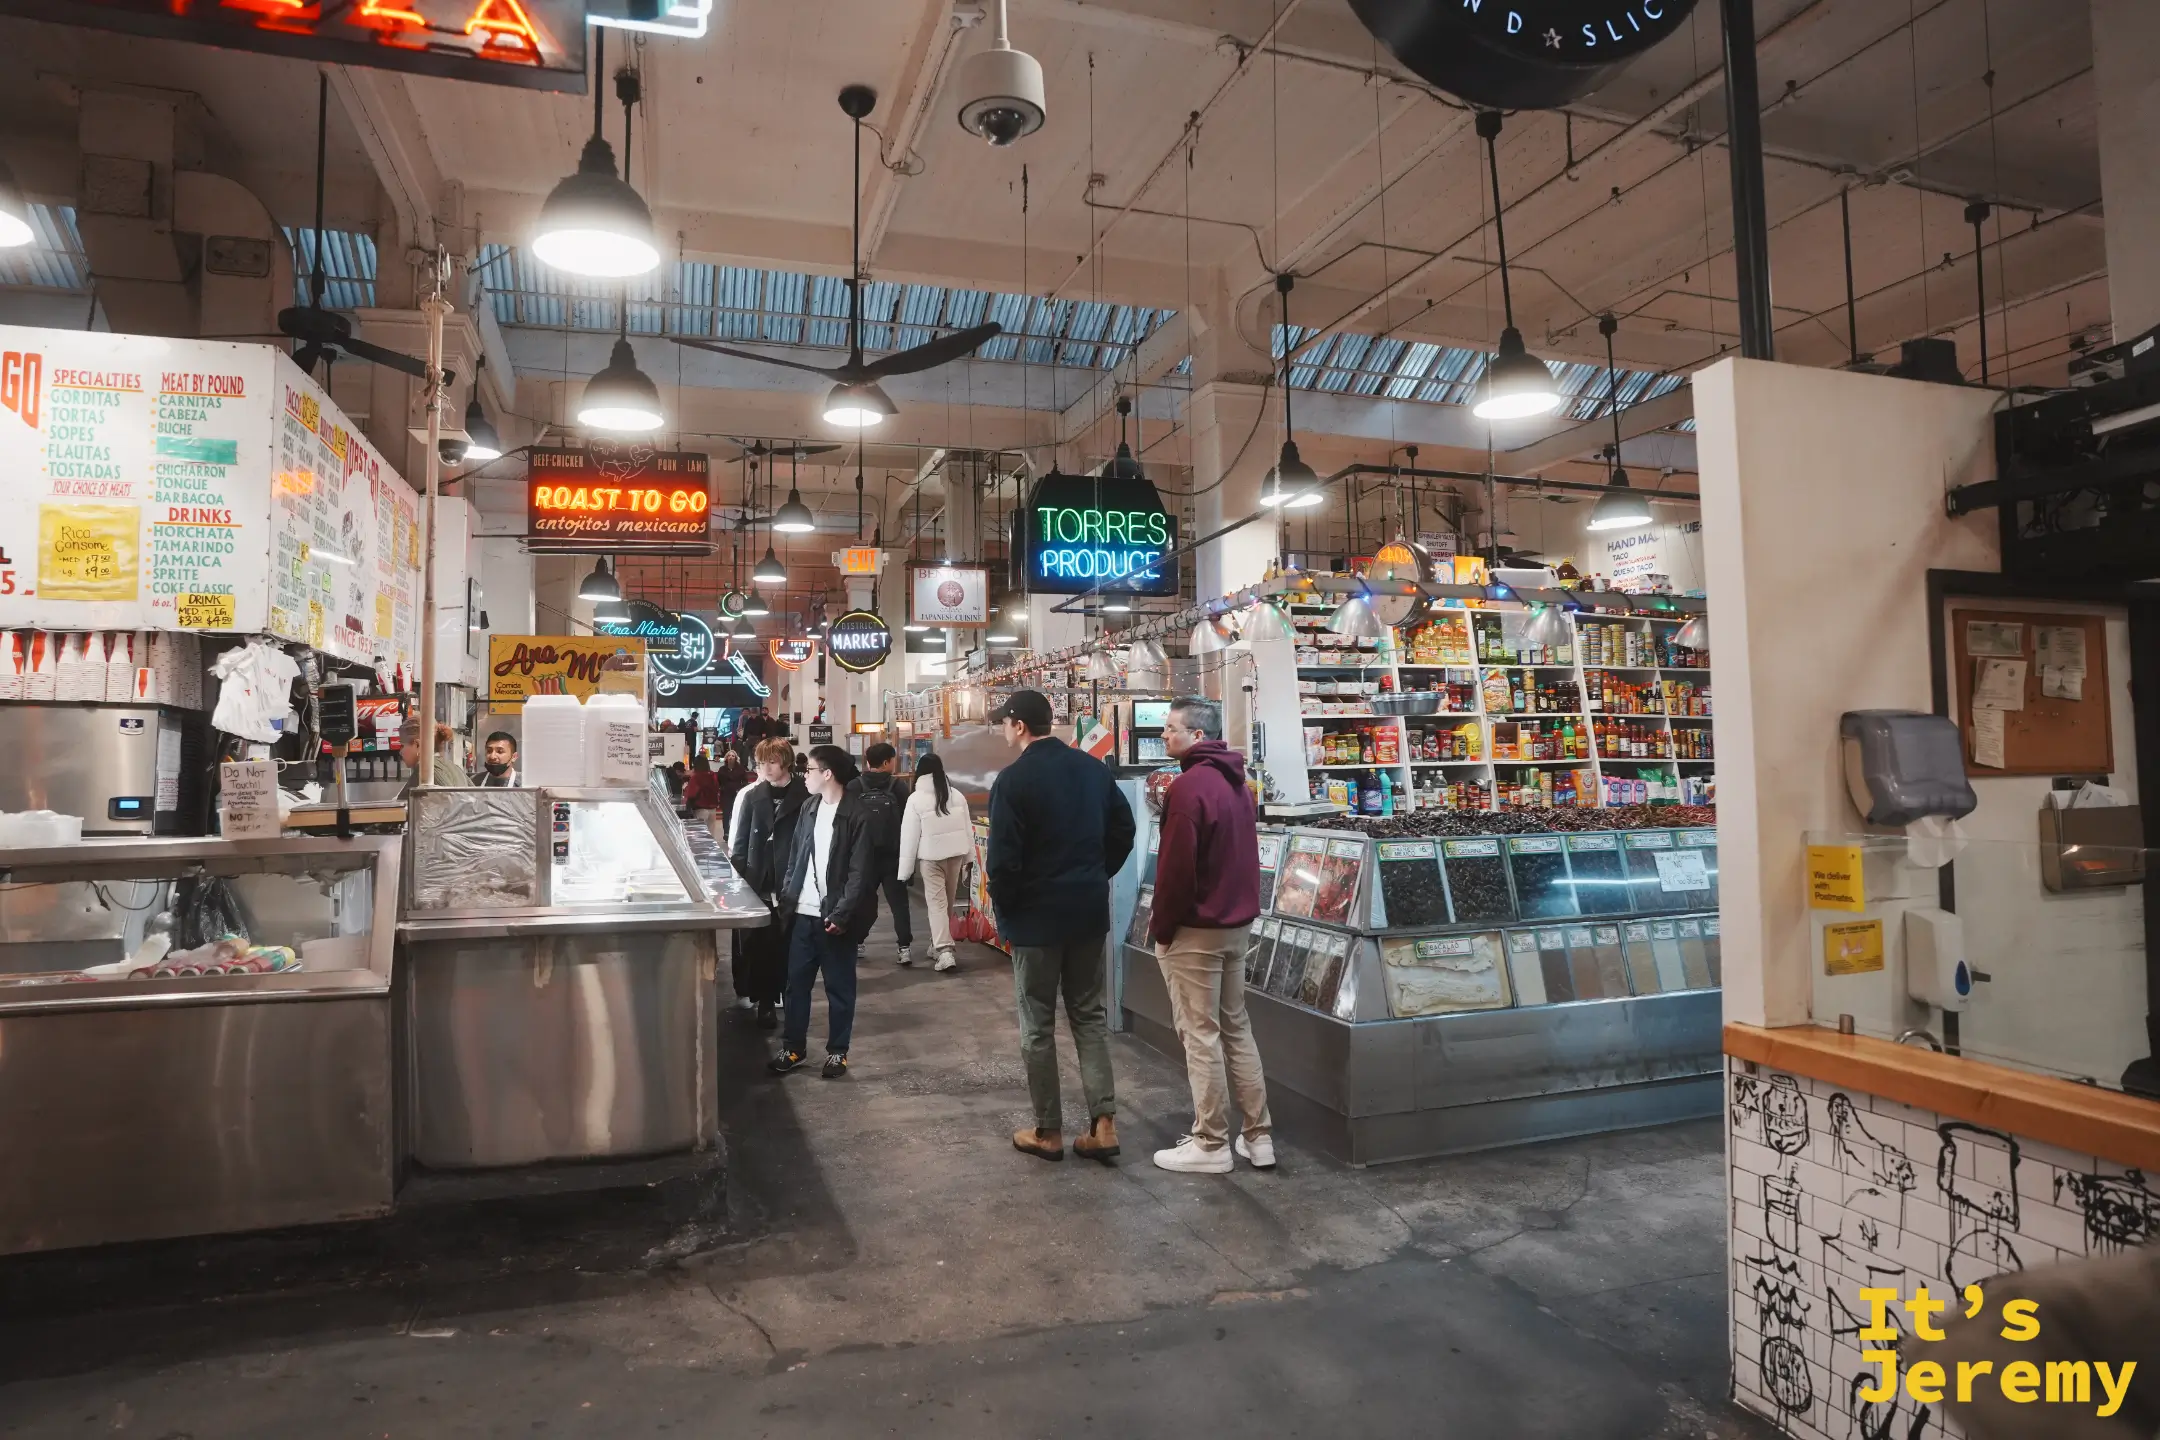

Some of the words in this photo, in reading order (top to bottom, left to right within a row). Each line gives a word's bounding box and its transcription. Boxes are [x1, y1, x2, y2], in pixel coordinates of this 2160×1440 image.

[53, 369, 141, 389] SPECIALTIES
[161, 372, 189, 392] MEAT
[192, 373, 205, 393] BY
[208, 375, 244, 395] POUND
[0, 351, 42, 430] GO
[50, 389, 121, 407] GORDITAS
[159, 395, 222, 409] CARNITAS
[50, 407, 105, 424] TORTAS
[158, 408, 207, 421] CABEZA
[49, 425, 95, 441] SOPES
[157, 422, 192, 435] BUCHE
[48, 444, 111, 461] FLAUTAS
[48, 461, 121, 479] TOSTADAS
[156, 463, 226, 478] CHICHARRON
[687, 459, 707, 473] LAMB
[52, 480, 71, 494] YOUR
[72, 481, 98, 496] CHOICE
[98, 483, 108, 496] OF
[109, 484, 132, 497] MEATS
[156, 477, 208, 490] TONGUE
[155, 491, 225, 506] BARBACOA
[535, 486, 622, 511] ROAST
[628, 489, 662, 512] TO
[669, 490, 707, 514] GO
[168, 507, 232, 524] DRINKS
[153, 525, 234, 539] HORCHATA
[535, 515, 611, 537] antojitos
[615, 517, 707, 534] mexicanos
[1037, 507, 1168, 546] TORRES
[154, 540, 234, 554] TAMARINDO
[1607, 537, 1636, 553] HAND
[153, 554, 222, 568] JAMAICA
[847, 549, 877, 572] EXIT
[1042, 548, 1161, 579] PRODUCE
[1612, 552, 1629, 562] TACO
[152, 568, 199, 580] SPRITE
[1612, 566, 1636, 577] QUESO
[1637, 562, 1654, 572] TACO
[152, 582, 185, 594] COKE
[189, 583, 233, 595] CLASSIC
[188, 594, 221, 605] DRINK
[920, 613, 953, 621] JAPANESE
[955, 614, 982, 622] CUISINE
[600, 620, 631, 635] Ana
[841, 621, 878, 630] DISTRICT
[334, 625, 356, 648] SINCE
[358, 636, 372, 655] 1952
[657, 636, 677, 646] TACOS
[832, 632, 889, 650] MARKET
[493, 643, 560, 677] Ana
[496, 681, 522, 689] Comida
[1813, 871, 1825, 879] We
[1827, 871, 1851, 881] deliver
